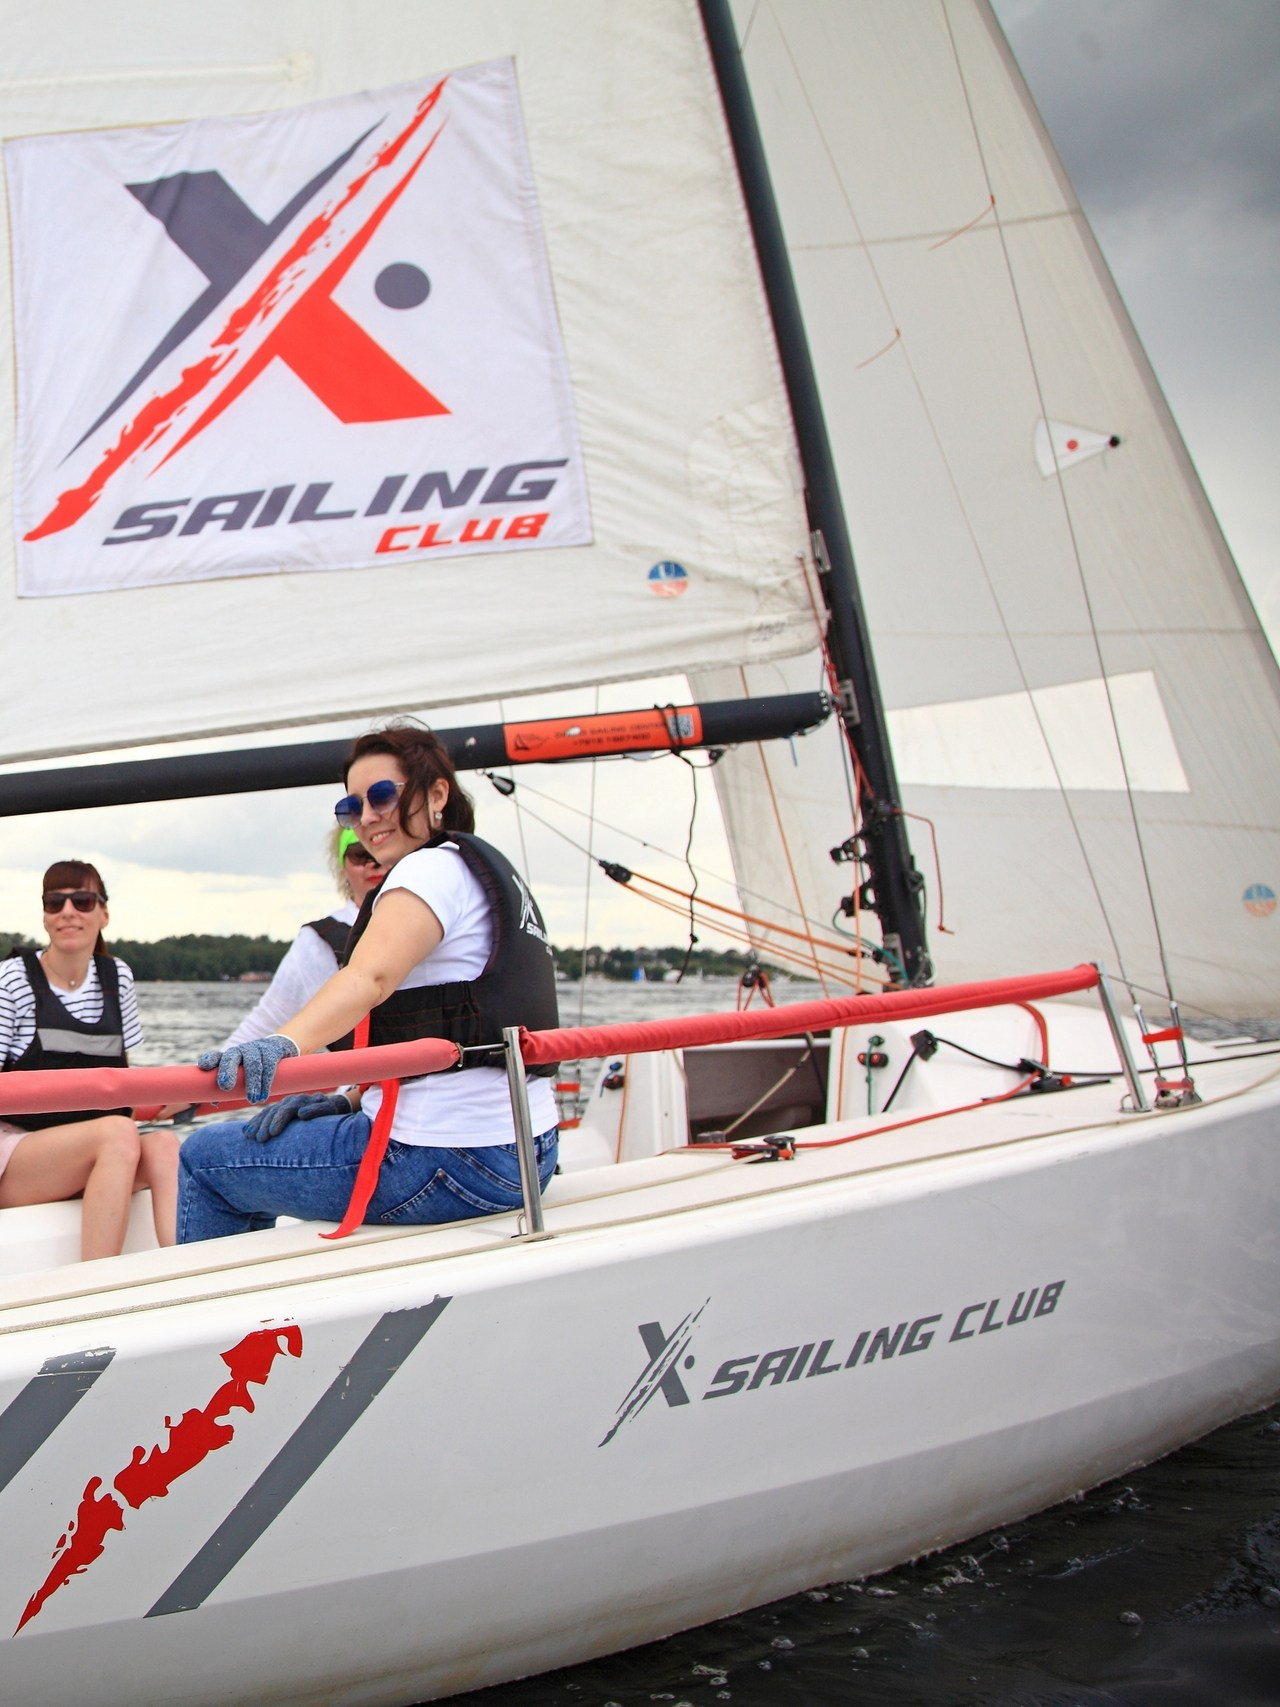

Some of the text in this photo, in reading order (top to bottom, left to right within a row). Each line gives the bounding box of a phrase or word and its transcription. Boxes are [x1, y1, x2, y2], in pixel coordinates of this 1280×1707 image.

[102, 458, 569, 546] SAILING
[375, 512, 549, 554] CLUB
[702, 1280, 1066, 1401] SAILING CLUB
